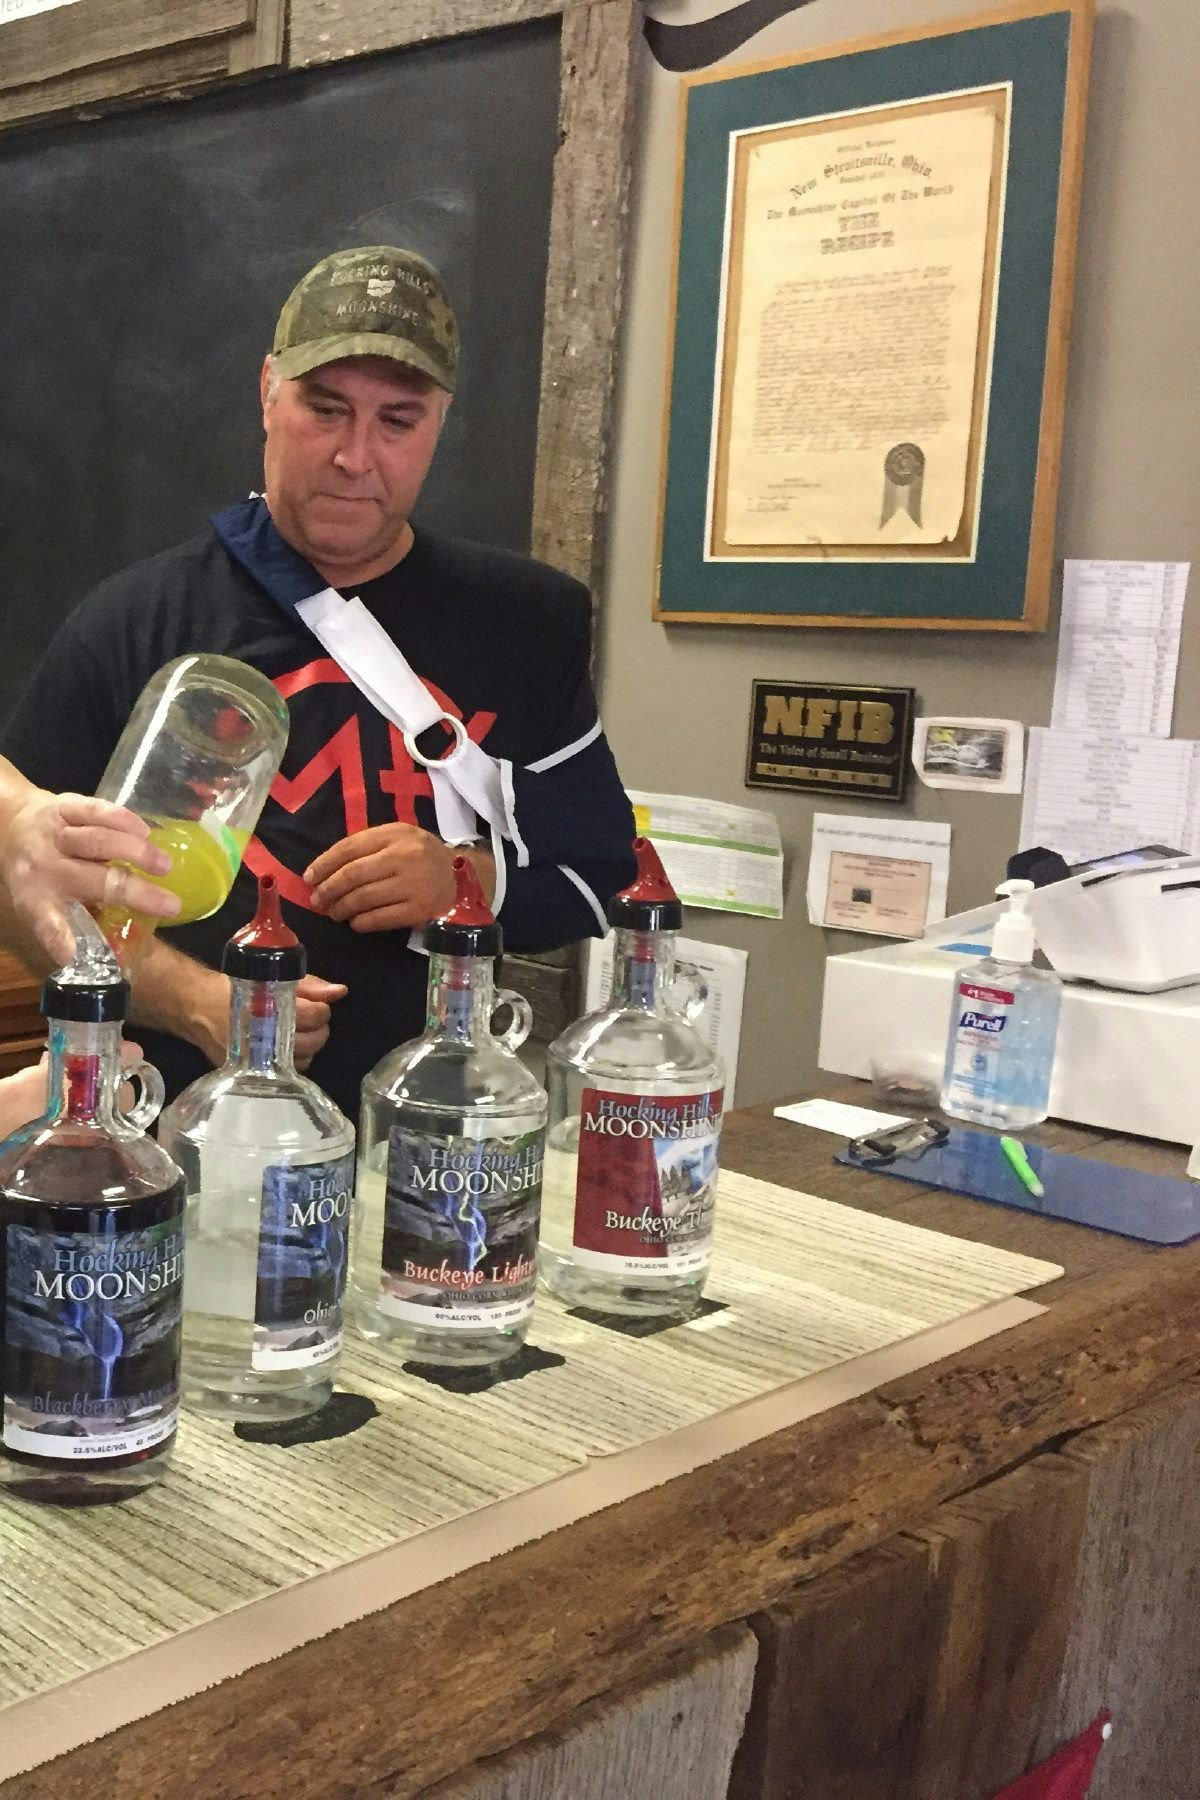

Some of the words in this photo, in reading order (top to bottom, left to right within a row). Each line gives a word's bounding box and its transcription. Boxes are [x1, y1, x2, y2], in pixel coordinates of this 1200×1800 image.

[789, 178, 818, 200] New
[767, 209, 784, 220] The
[762, 695, 896, 745] NFIB
[760, 742, 777, 755] The
[807, 746, 818, 757] of
[820, 747, 848, 761] Small
[965, 1012, 1003, 1031] Purell
[584, 1112, 722, 1140] MOONSHIN
[598, 1096, 678, 1126] Hocking
[428, 1142, 520, 1171] Hocking
[411, 1160, 542, 1194] MOONSHI
[290, 1189, 350, 1228] MOO
[605, 1206, 682, 1238] Buckeye
[54, 1239, 158, 1273] Hocking
[33, 1251, 183, 1301] MOONSHI
[403, 1258, 485, 1290] Buckeye
